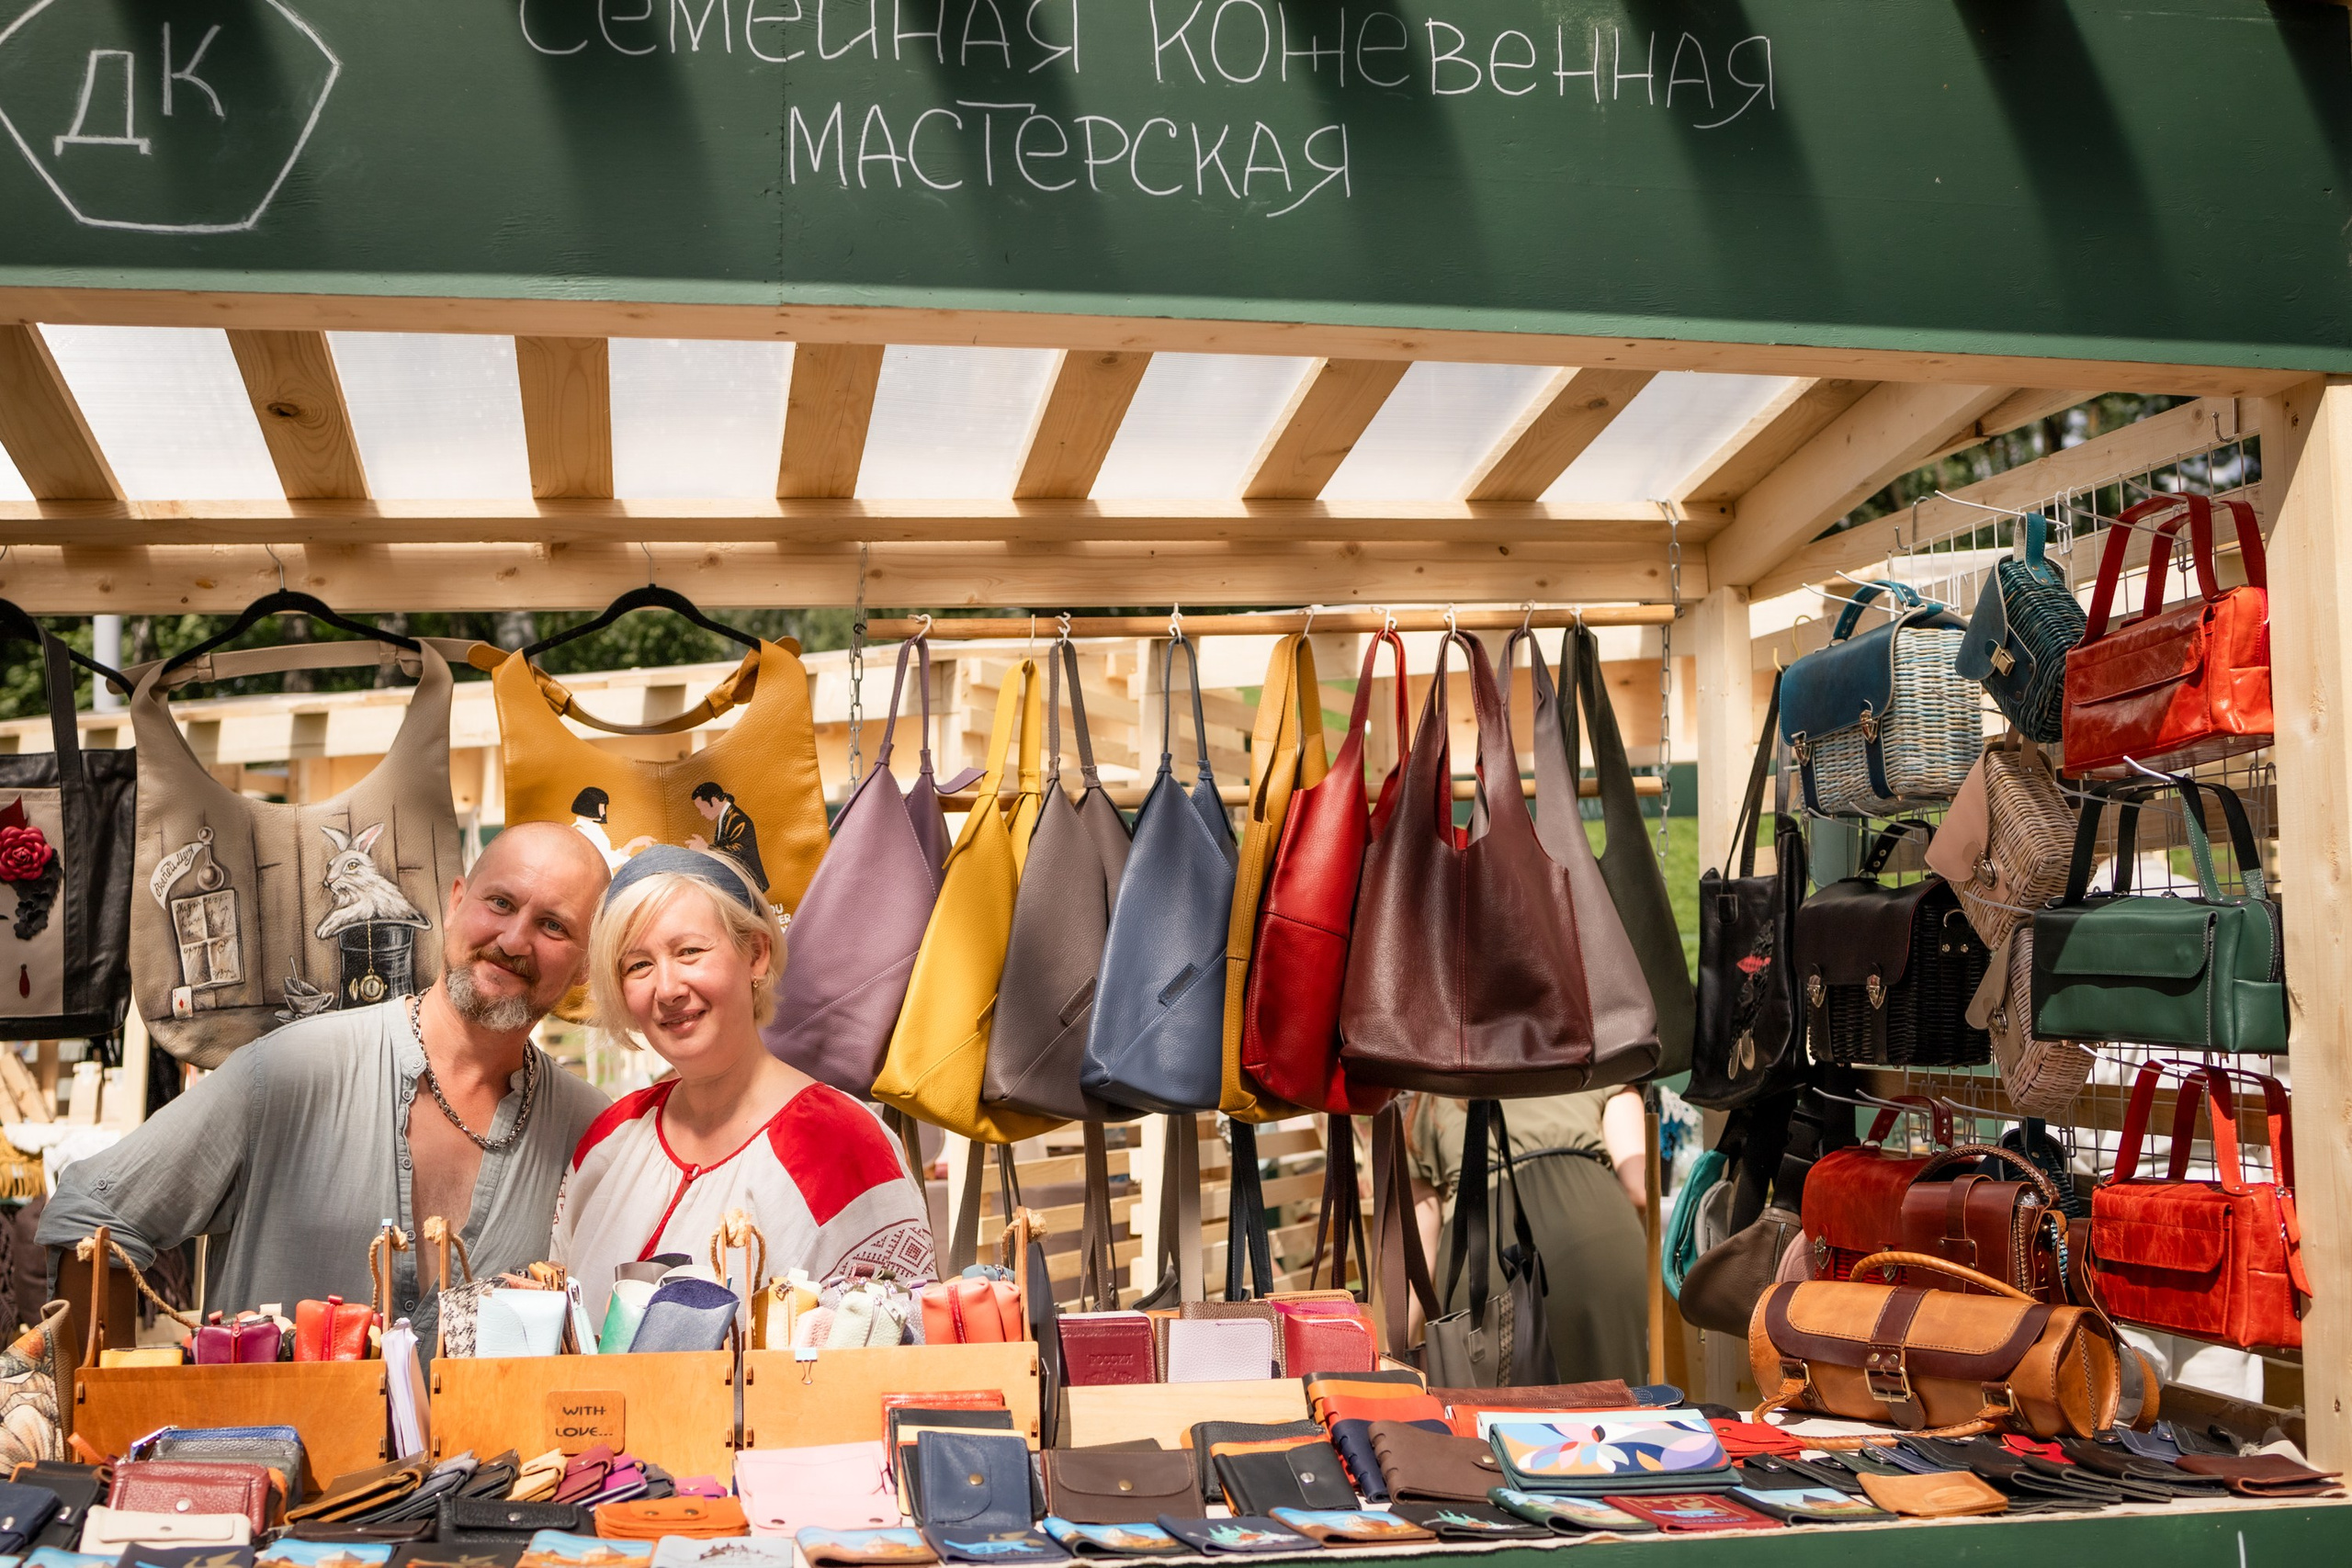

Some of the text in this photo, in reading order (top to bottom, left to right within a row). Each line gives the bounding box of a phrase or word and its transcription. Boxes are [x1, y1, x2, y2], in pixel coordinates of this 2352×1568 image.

[54, 21, 227, 156] ДК
[1087, 1352, 1134, 1367] РОССИЯ
[562, 1405, 606, 1416] WITH
[555, 1427, 613, 1438] LOVE...
